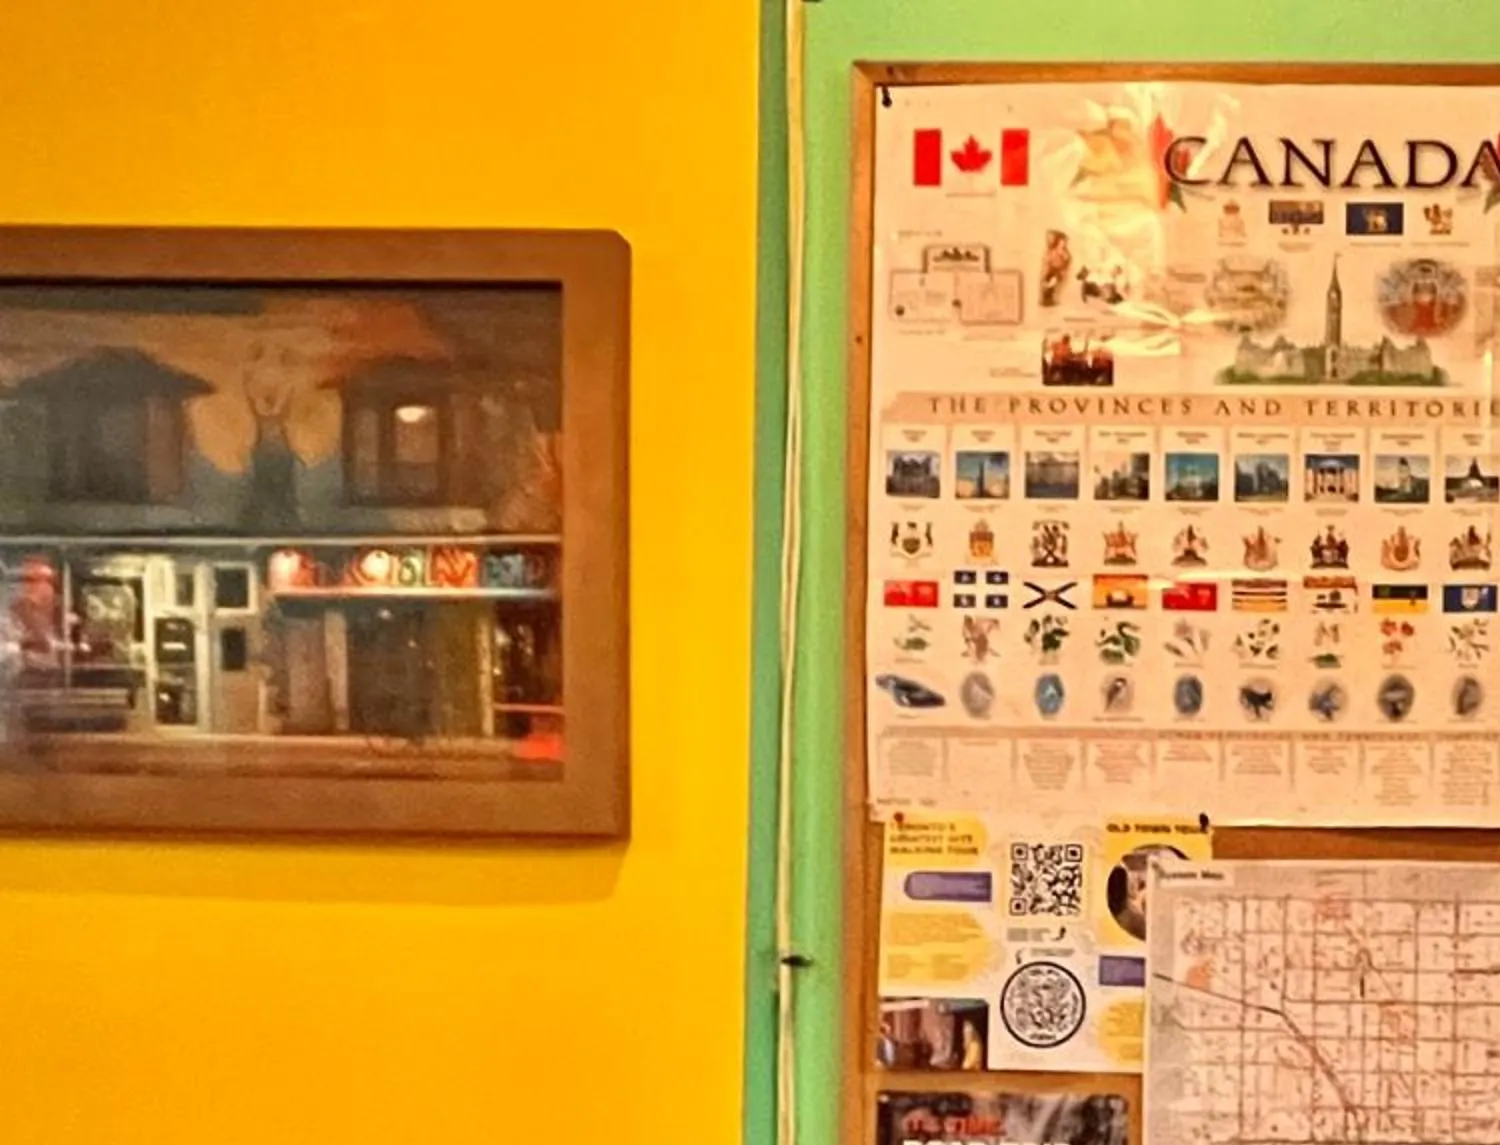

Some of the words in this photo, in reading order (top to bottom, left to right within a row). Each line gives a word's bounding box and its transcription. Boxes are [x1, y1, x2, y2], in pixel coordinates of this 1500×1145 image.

[929, 398, 987, 413] THE
[1009, 398, 1192, 415] PROVINCES
[1215, 400, 1283, 416] AND
